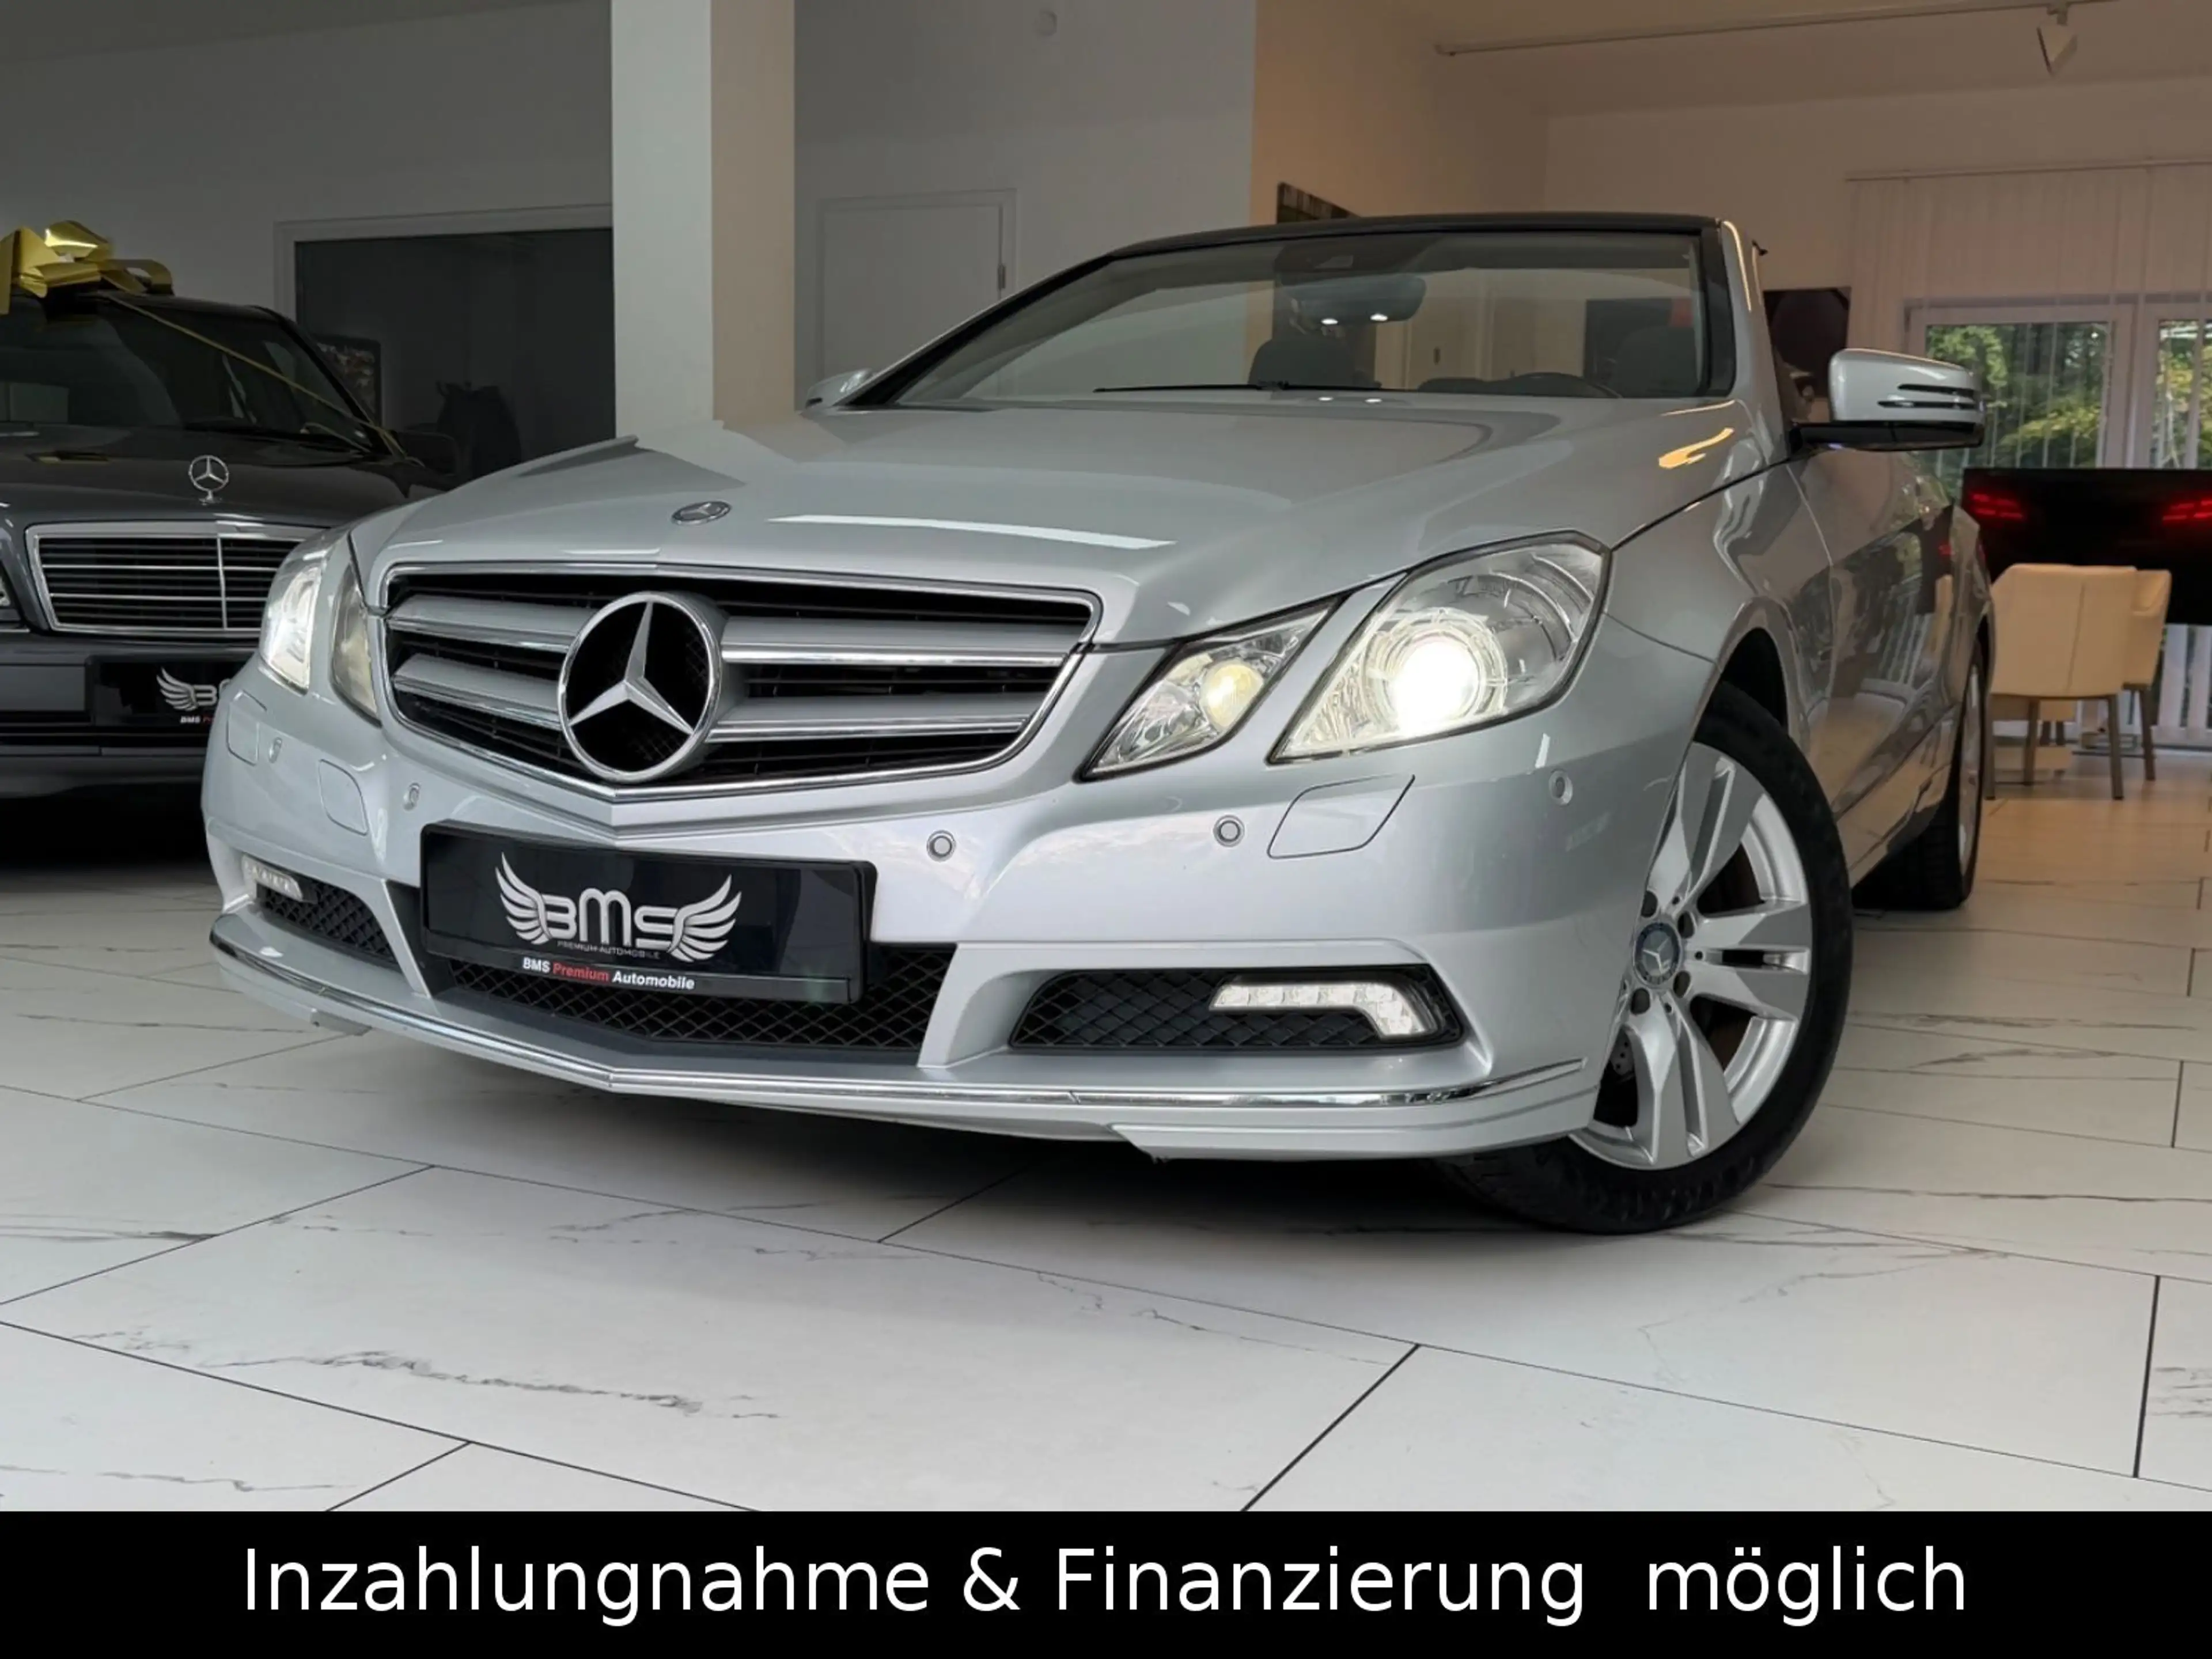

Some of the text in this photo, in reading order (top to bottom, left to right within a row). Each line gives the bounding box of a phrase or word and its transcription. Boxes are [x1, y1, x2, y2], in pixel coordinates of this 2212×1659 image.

[522, 957, 695, 990] BMS Premium Automobile
